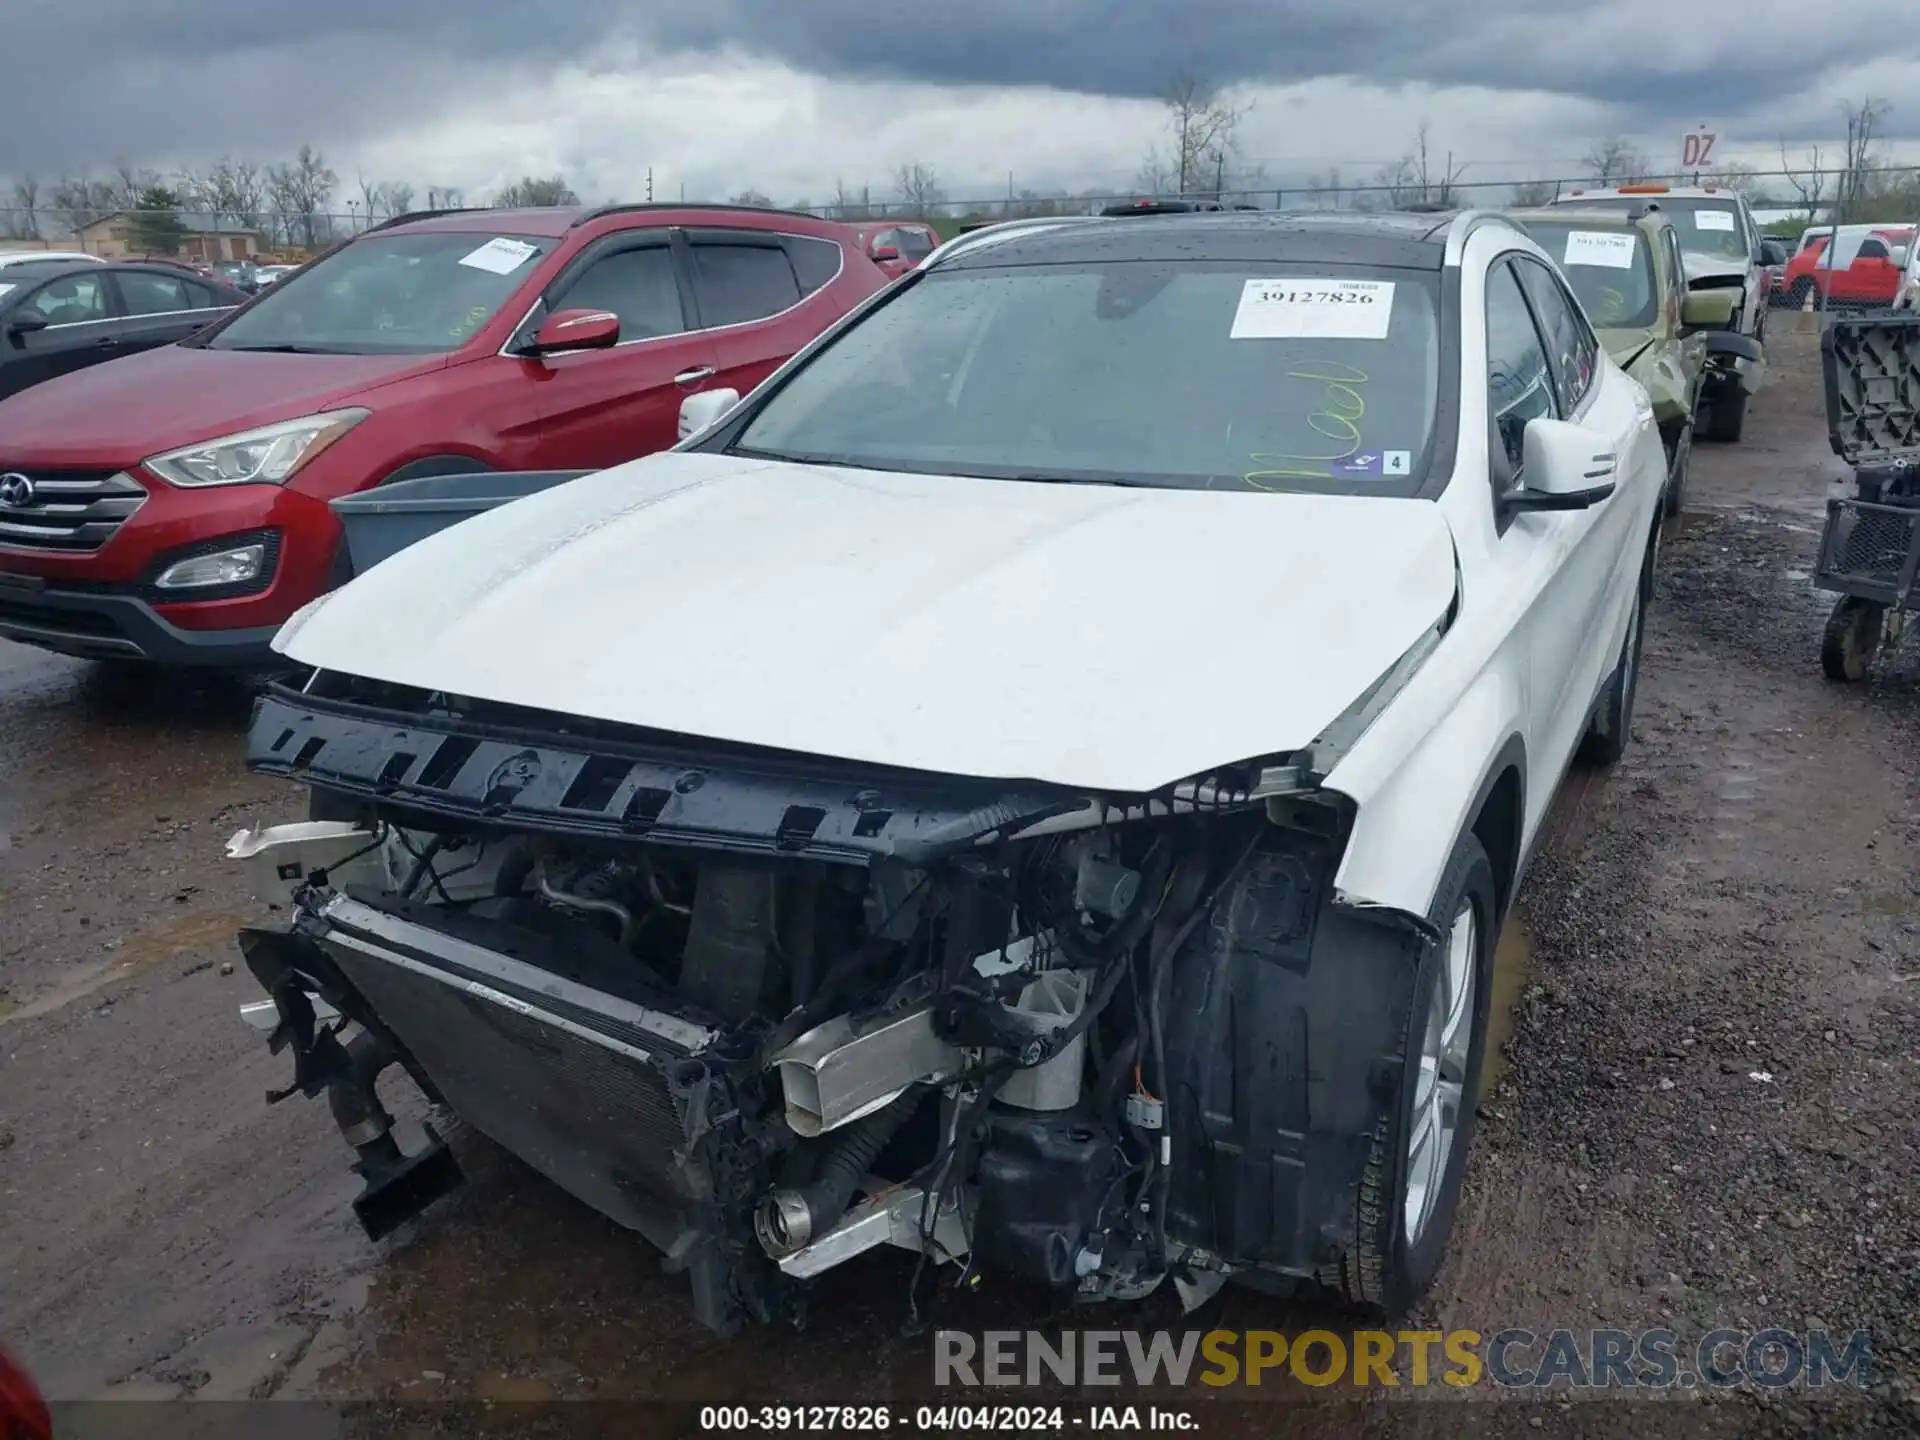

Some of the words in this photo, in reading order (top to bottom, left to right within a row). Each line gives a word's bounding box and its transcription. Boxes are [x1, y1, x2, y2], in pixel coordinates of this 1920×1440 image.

[1682, 133, 1716, 166] DZ
[1255, 290, 1375, 304] 39127826
[1390, 456, 1402, 470] 4
